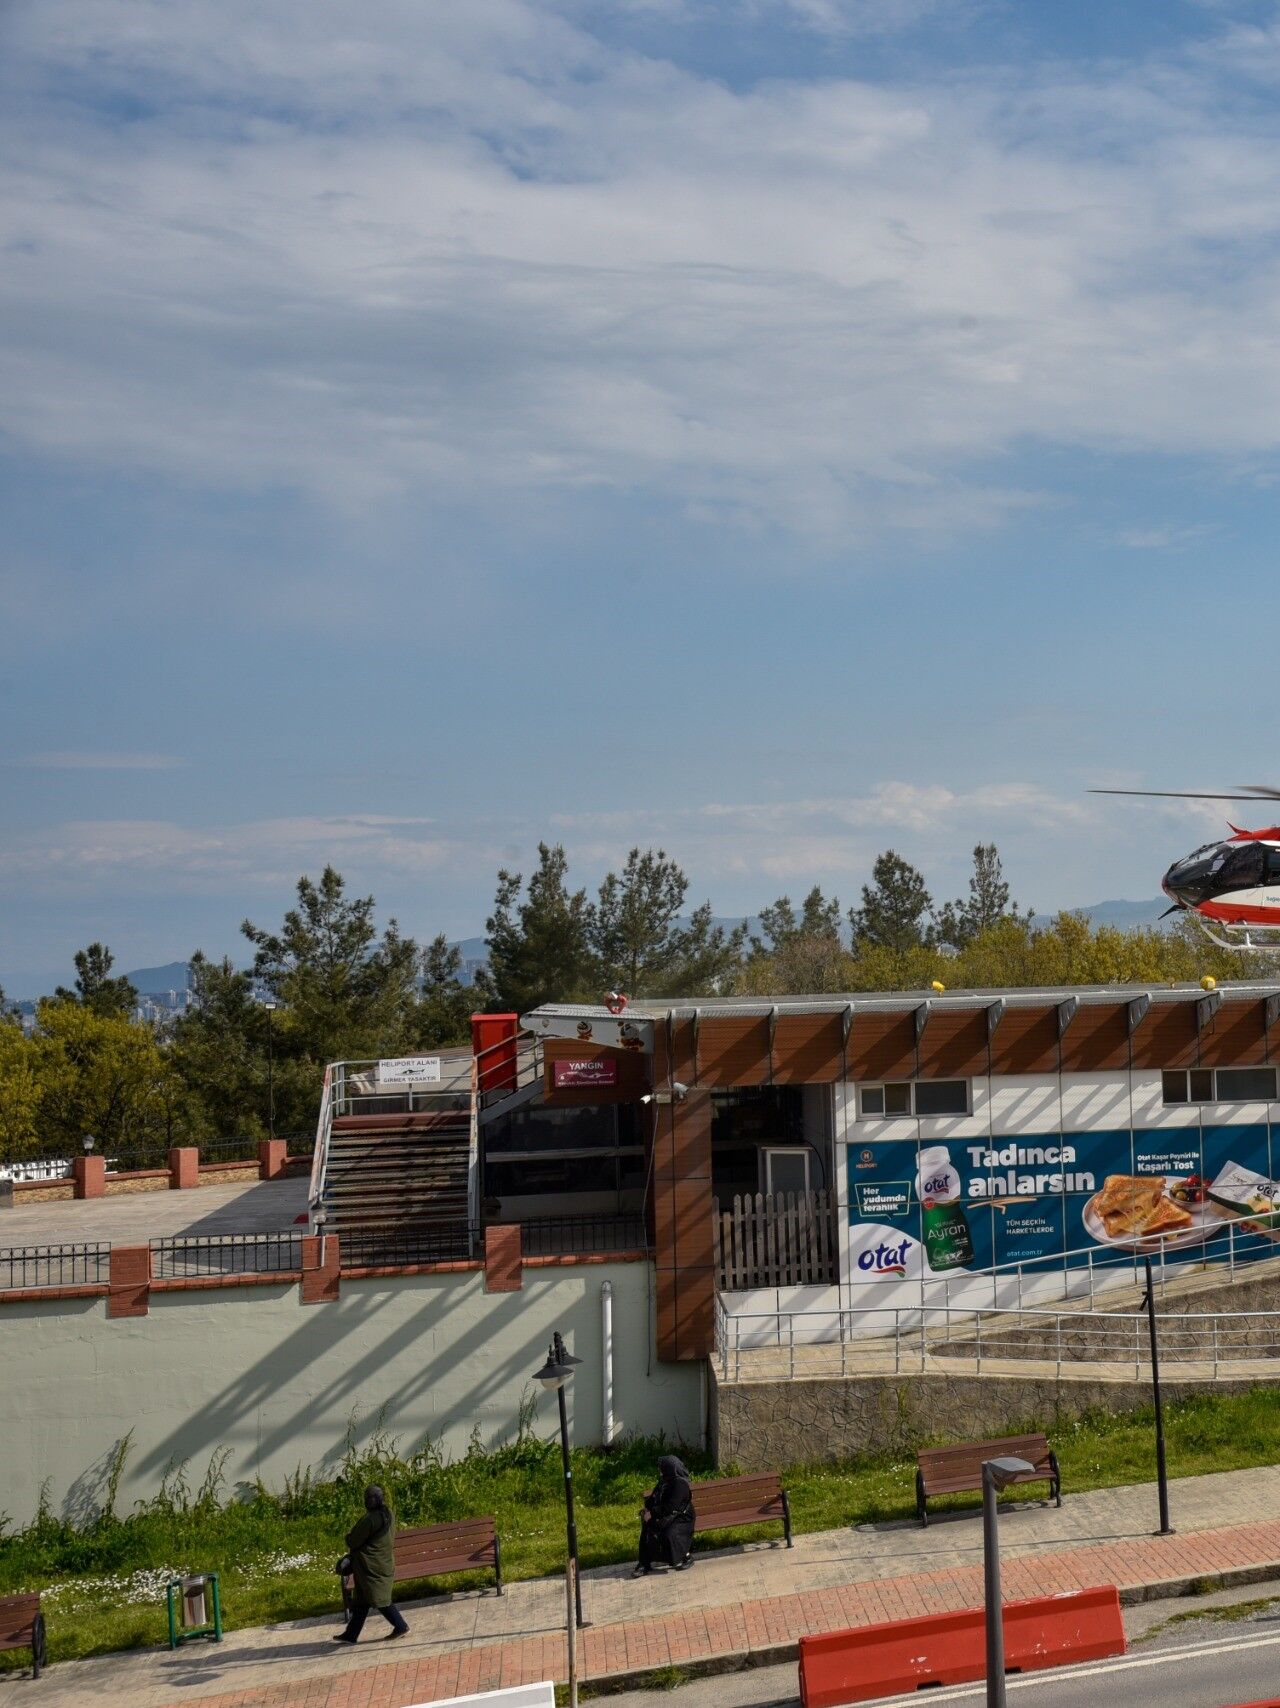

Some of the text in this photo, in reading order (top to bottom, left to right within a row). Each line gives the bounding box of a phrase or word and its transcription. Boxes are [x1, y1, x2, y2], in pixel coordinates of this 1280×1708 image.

[569, 1062, 604, 1070] YANGIN
[966, 1143, 1076, 1168] Tadınca
[1137, 1160, 1195, 1174] Kaşarlı Tost
[924, 1174, 950, 1193] otat
[968, 1170, 1095, 1197] anlarsın
[863, 1187, 880, 1195] Her
[863, 1194, 907, 1205] yudumda
[1006, 1218, 1046, 1226] TÜM SEÇKİN
[927, 1224, 967, 1240] Ayran
[1006, 1226, 1055, 1235] MARKETLERDE
[857, 1238, 912, 1271] otat
